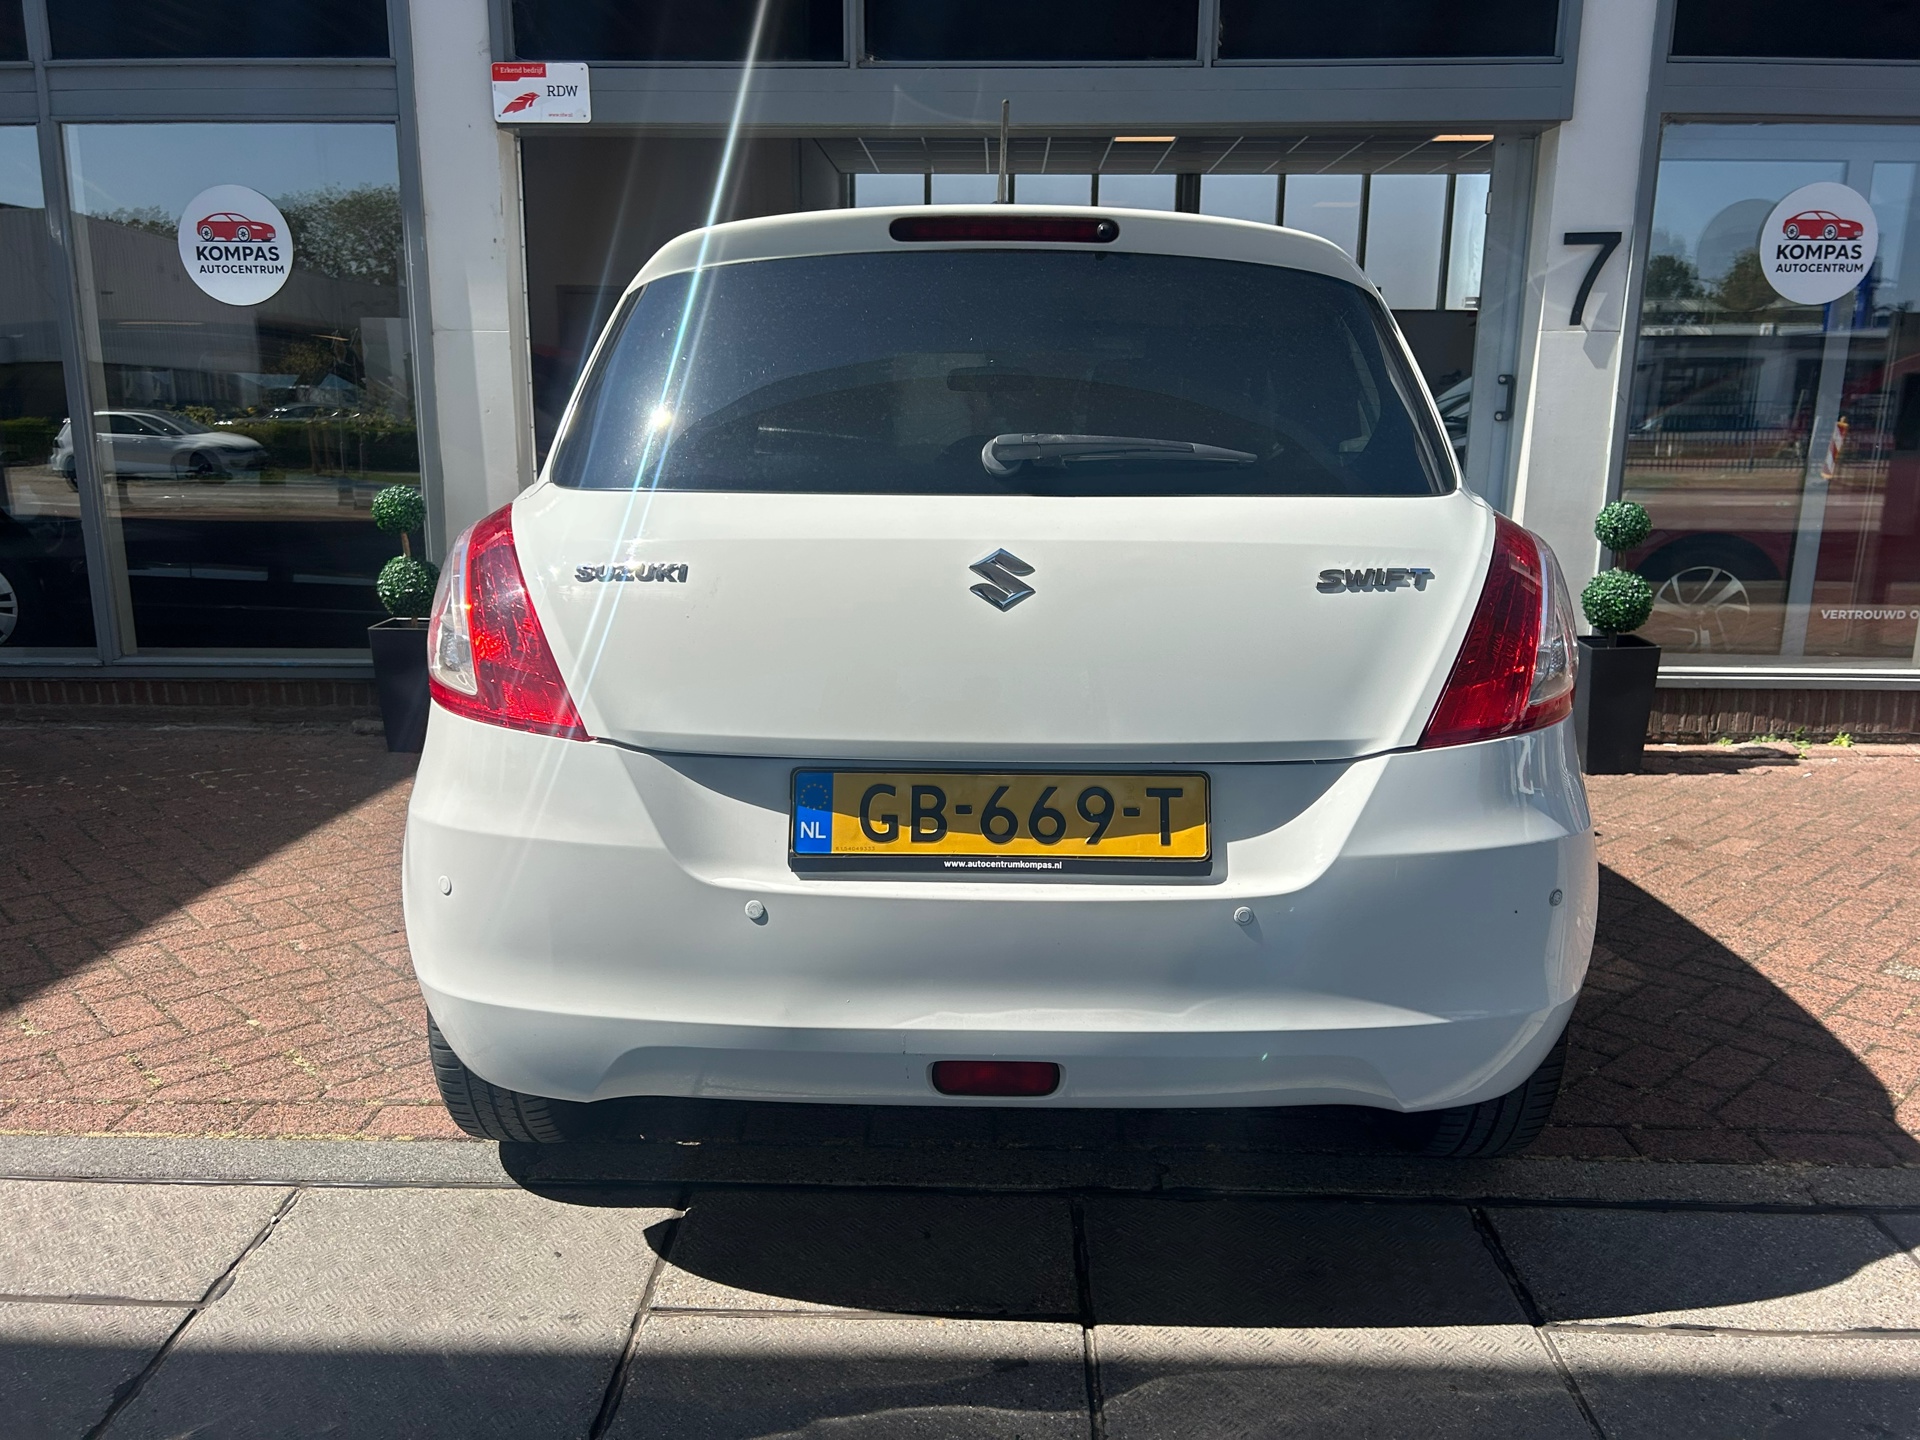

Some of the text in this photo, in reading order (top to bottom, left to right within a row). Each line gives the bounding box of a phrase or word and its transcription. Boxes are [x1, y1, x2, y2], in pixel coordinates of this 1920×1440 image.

[500, 66, 544, 75] Erkend bedrijf
[546, 85, 578, 97] RDW
[195, 245, 280, 261] KOMPAS
[1776, 244, 1863, 260] KOMPAS
[199, 264, 285, 274] AUTOCENTRUM
[1775, 263, 1864, 273] AUTOCENTRUM
[1564, 231, 1622, 326] 7
[574, 562, 689, 583] SUZUKI
[1316, 567, 1436, 594] SWIFT
[1821, 609, 1906, 620] VERTROUWD
[858, 783, 1184, 847] GB-669-T
[800, 821, 826, 839] NL
[943, 860, 1062, 870] www.autocentrumkompas.nl
